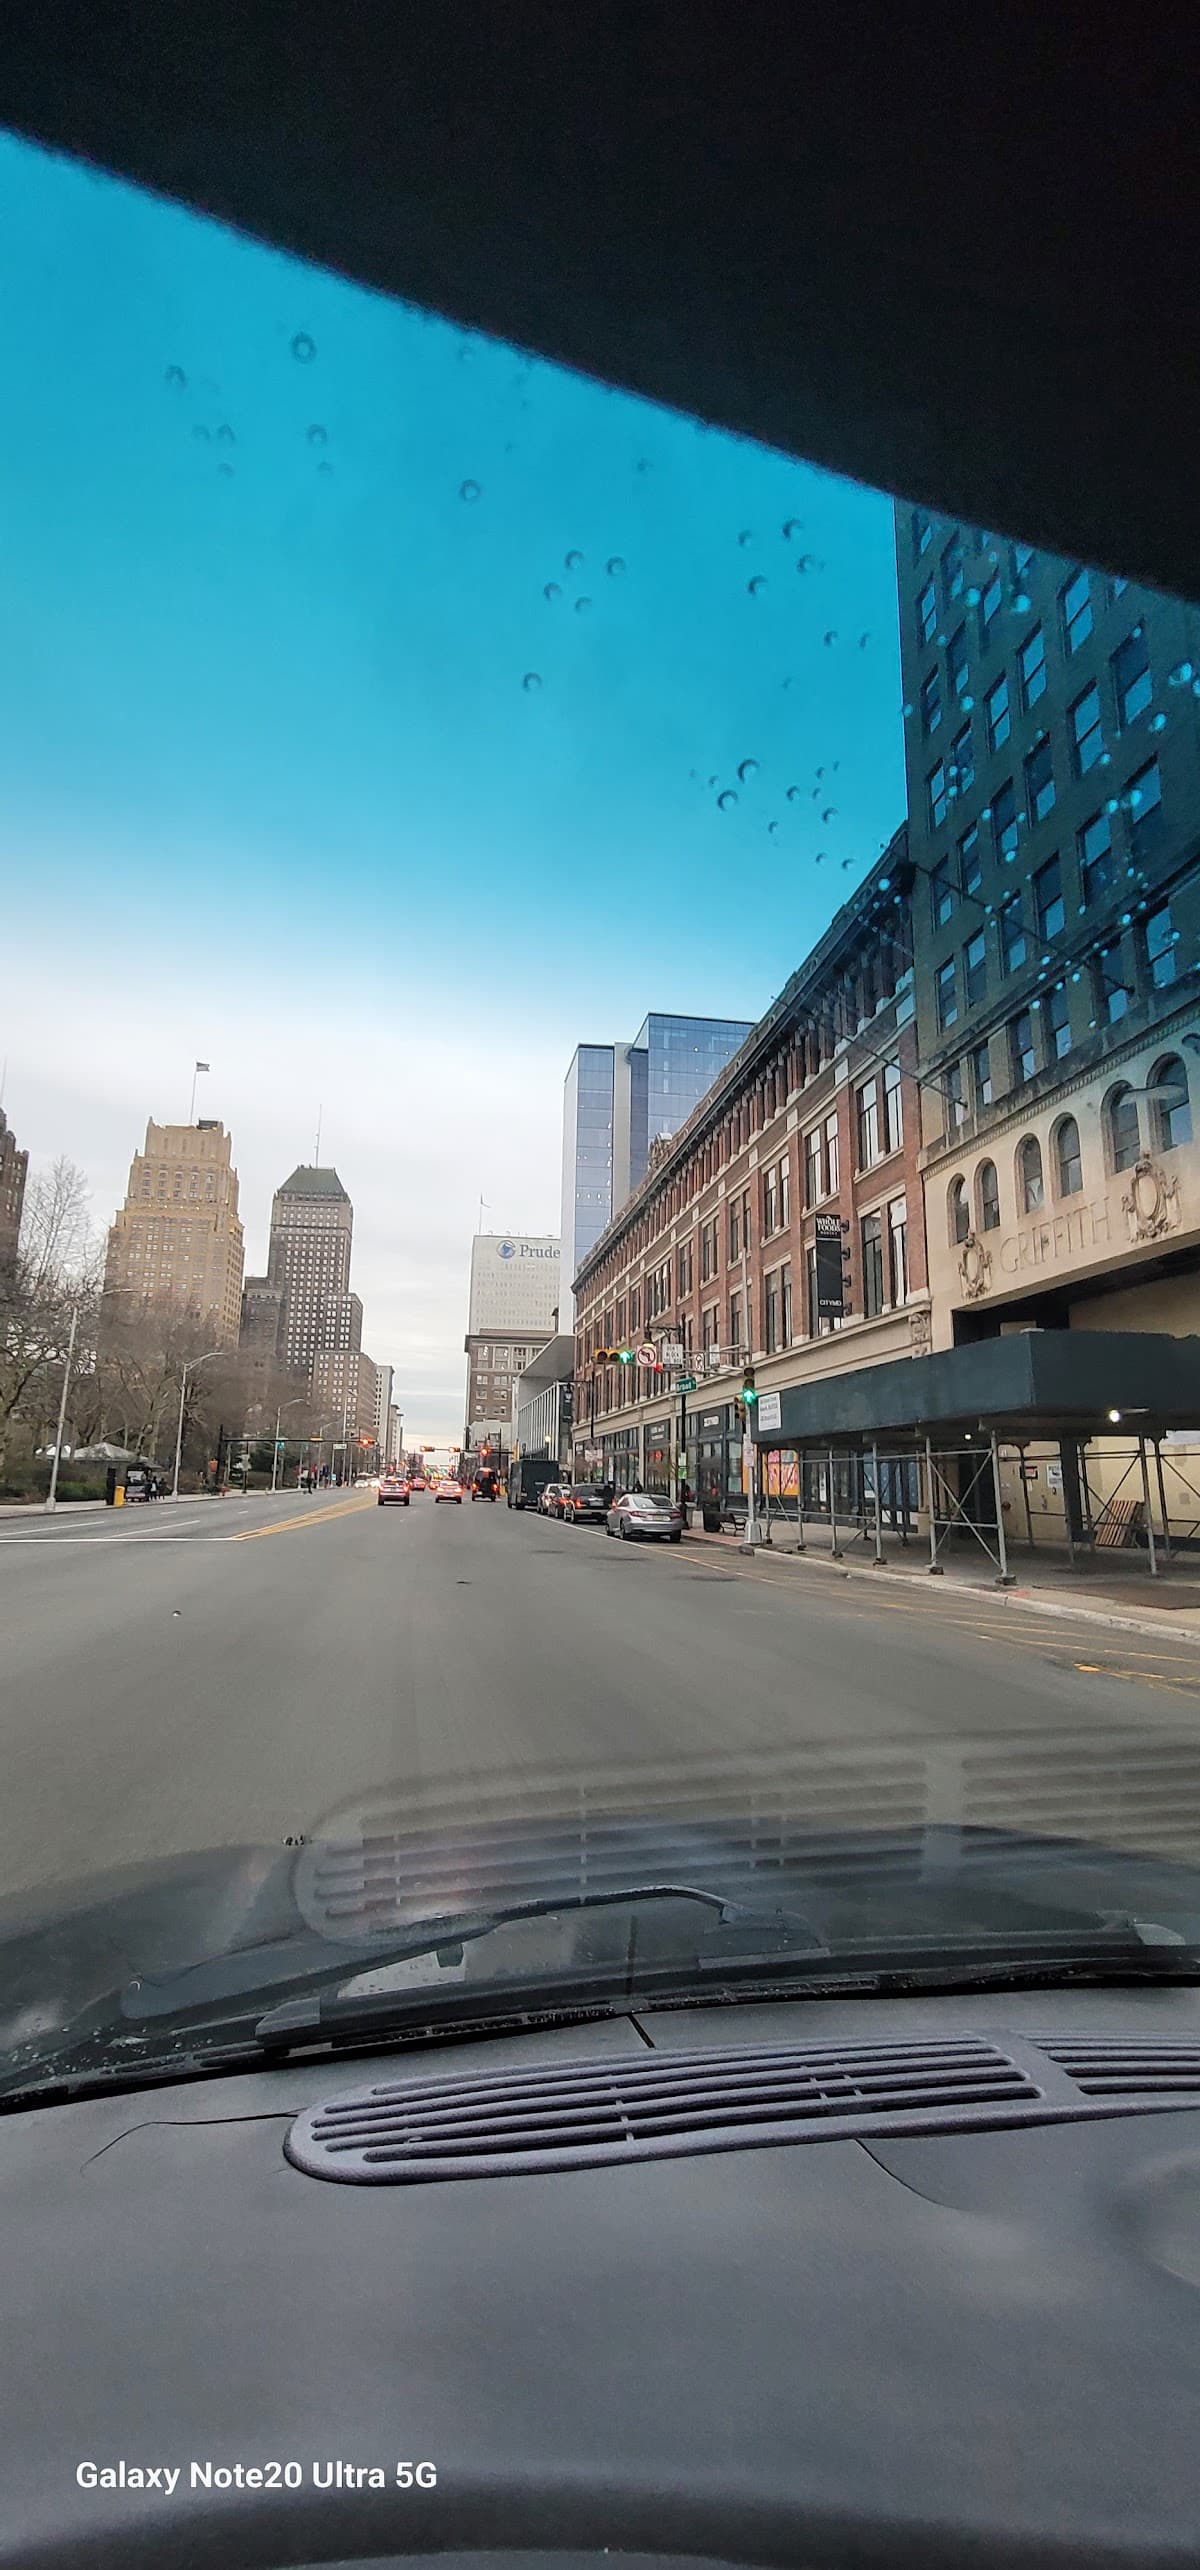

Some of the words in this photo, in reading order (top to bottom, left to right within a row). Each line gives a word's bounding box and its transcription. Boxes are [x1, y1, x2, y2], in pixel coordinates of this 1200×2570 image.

[816, 1216, 840, 1226] WHOLE
[817, 1224, 841, 1232] FOODS
[1000, 1196, 1112, 1273] GRIFFITH
